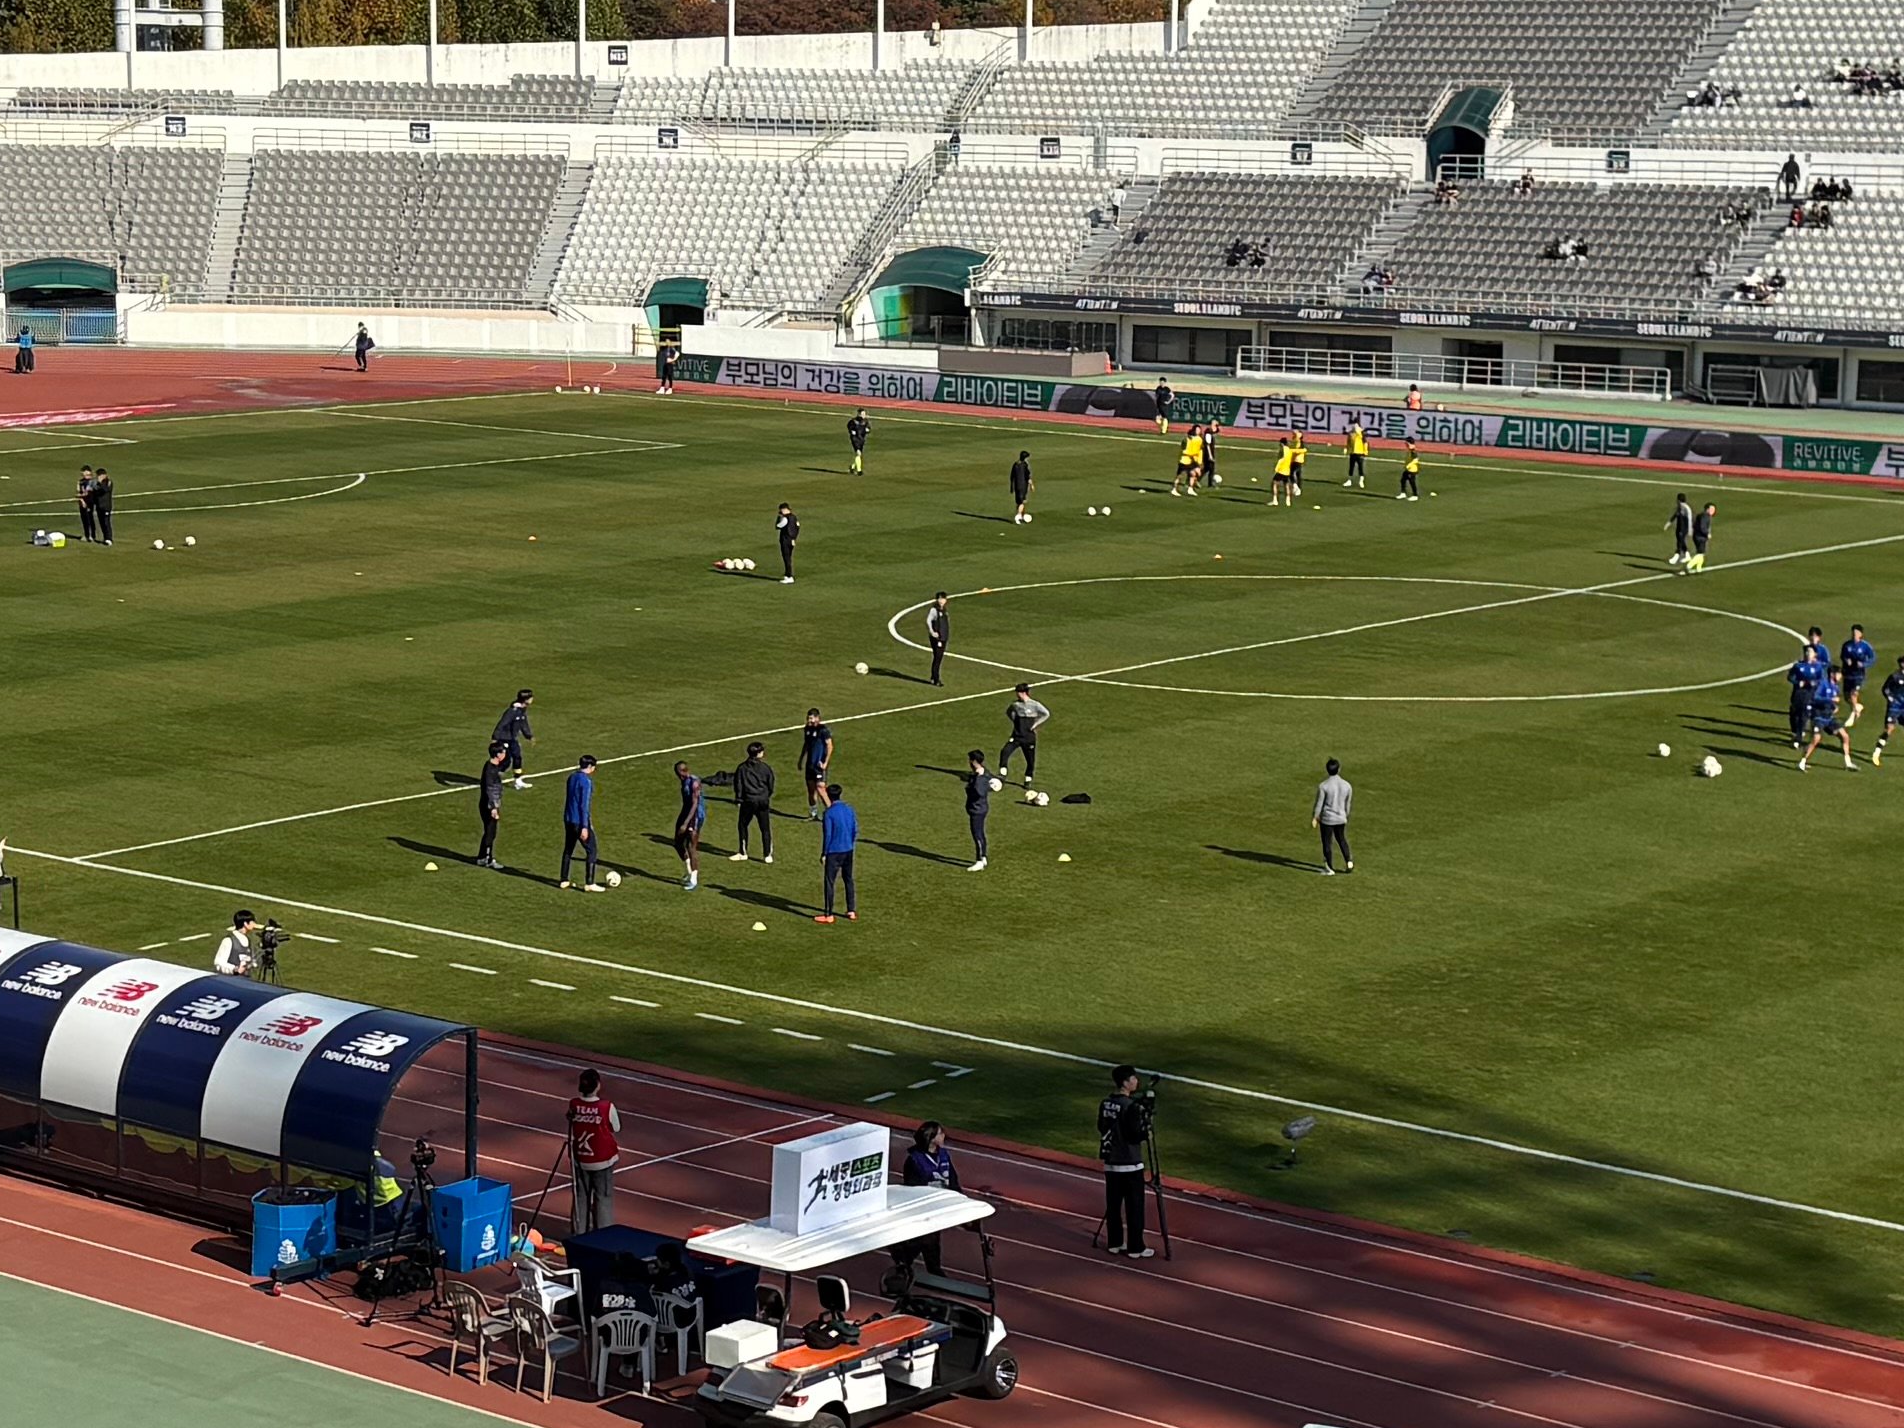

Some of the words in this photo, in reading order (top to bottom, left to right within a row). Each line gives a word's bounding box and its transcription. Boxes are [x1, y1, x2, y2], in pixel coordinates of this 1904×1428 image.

[673, 358, 711, 372] EVITIVE
[725, 359, 796, 388] 부모님의
[806, 368, 860, 396] 건강을
[944, 377, 1041, 408] 리바이티브
[1172, 398, 1228, 414] REVITIVE
[1245, 400, 1331, 431] 부모님의
[1507, 419, 1630, 456] 리바이티브
[1794, 442, 1862, 462] REVITIVE
[2, 979, 21, 991] new
[22, 982, 62, 1000] balance
[78, 995, 98, 1008] new
[98, 998, 139, 1016] balance
[156, 1013, 178, 1027] new
[178, 1016, 221, 1036] balance
[239, 1031, 260, 1044] new
[260, 1034, 303, 1052] balance
[321, 1048, 344, 1063] new
[344, 1051, 391, 1072] balance
